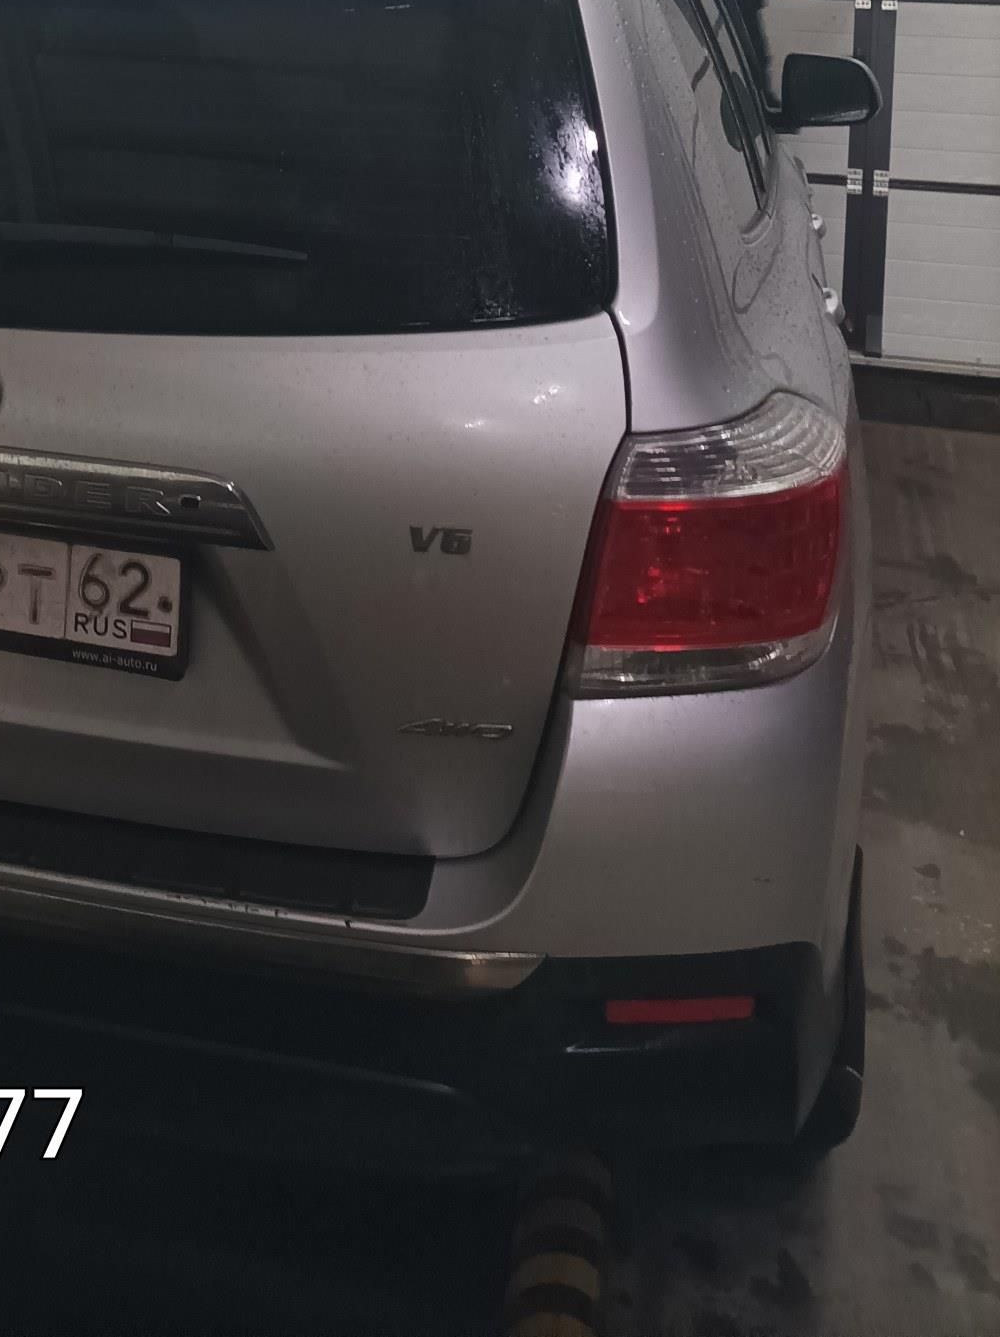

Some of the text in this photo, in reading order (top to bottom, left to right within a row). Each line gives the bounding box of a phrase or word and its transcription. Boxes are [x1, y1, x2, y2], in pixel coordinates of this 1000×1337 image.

[409, 525, 473, 556] V6
[79, 553, 152, 617] 62
[74, 613, 128, 640] RUS
[72, 649, 158, 672] www.ai-auto.ru
